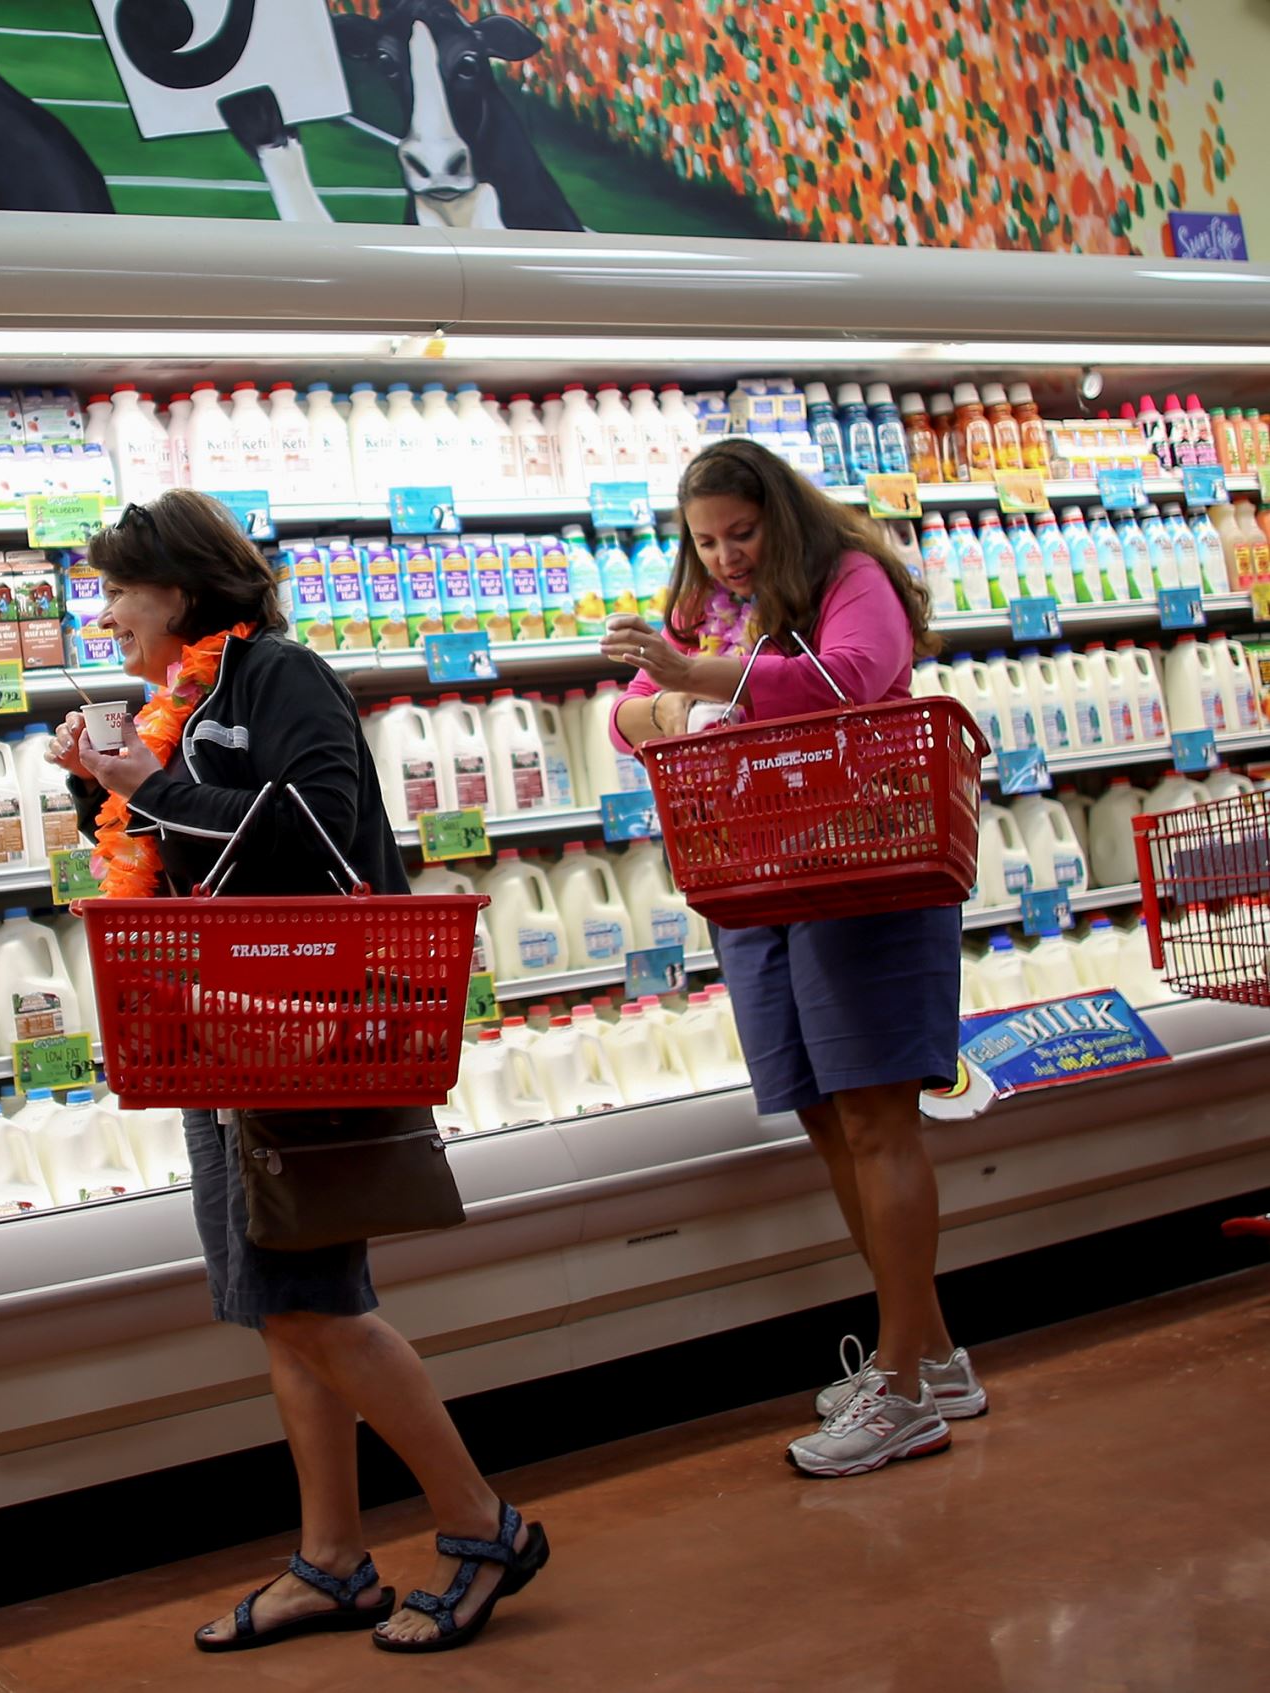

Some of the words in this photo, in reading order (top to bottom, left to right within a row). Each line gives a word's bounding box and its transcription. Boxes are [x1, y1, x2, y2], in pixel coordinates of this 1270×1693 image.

[751, 754, 797, 772] TRADER
[801, 748, 834, 764] JOE'S
[231, 943, 289, 957] TRADER
[292, 942, 337, 956] JOE'S
[1005, 998, 1130, 1047] MILK
[45, 1049, 63, 1063] LOW
